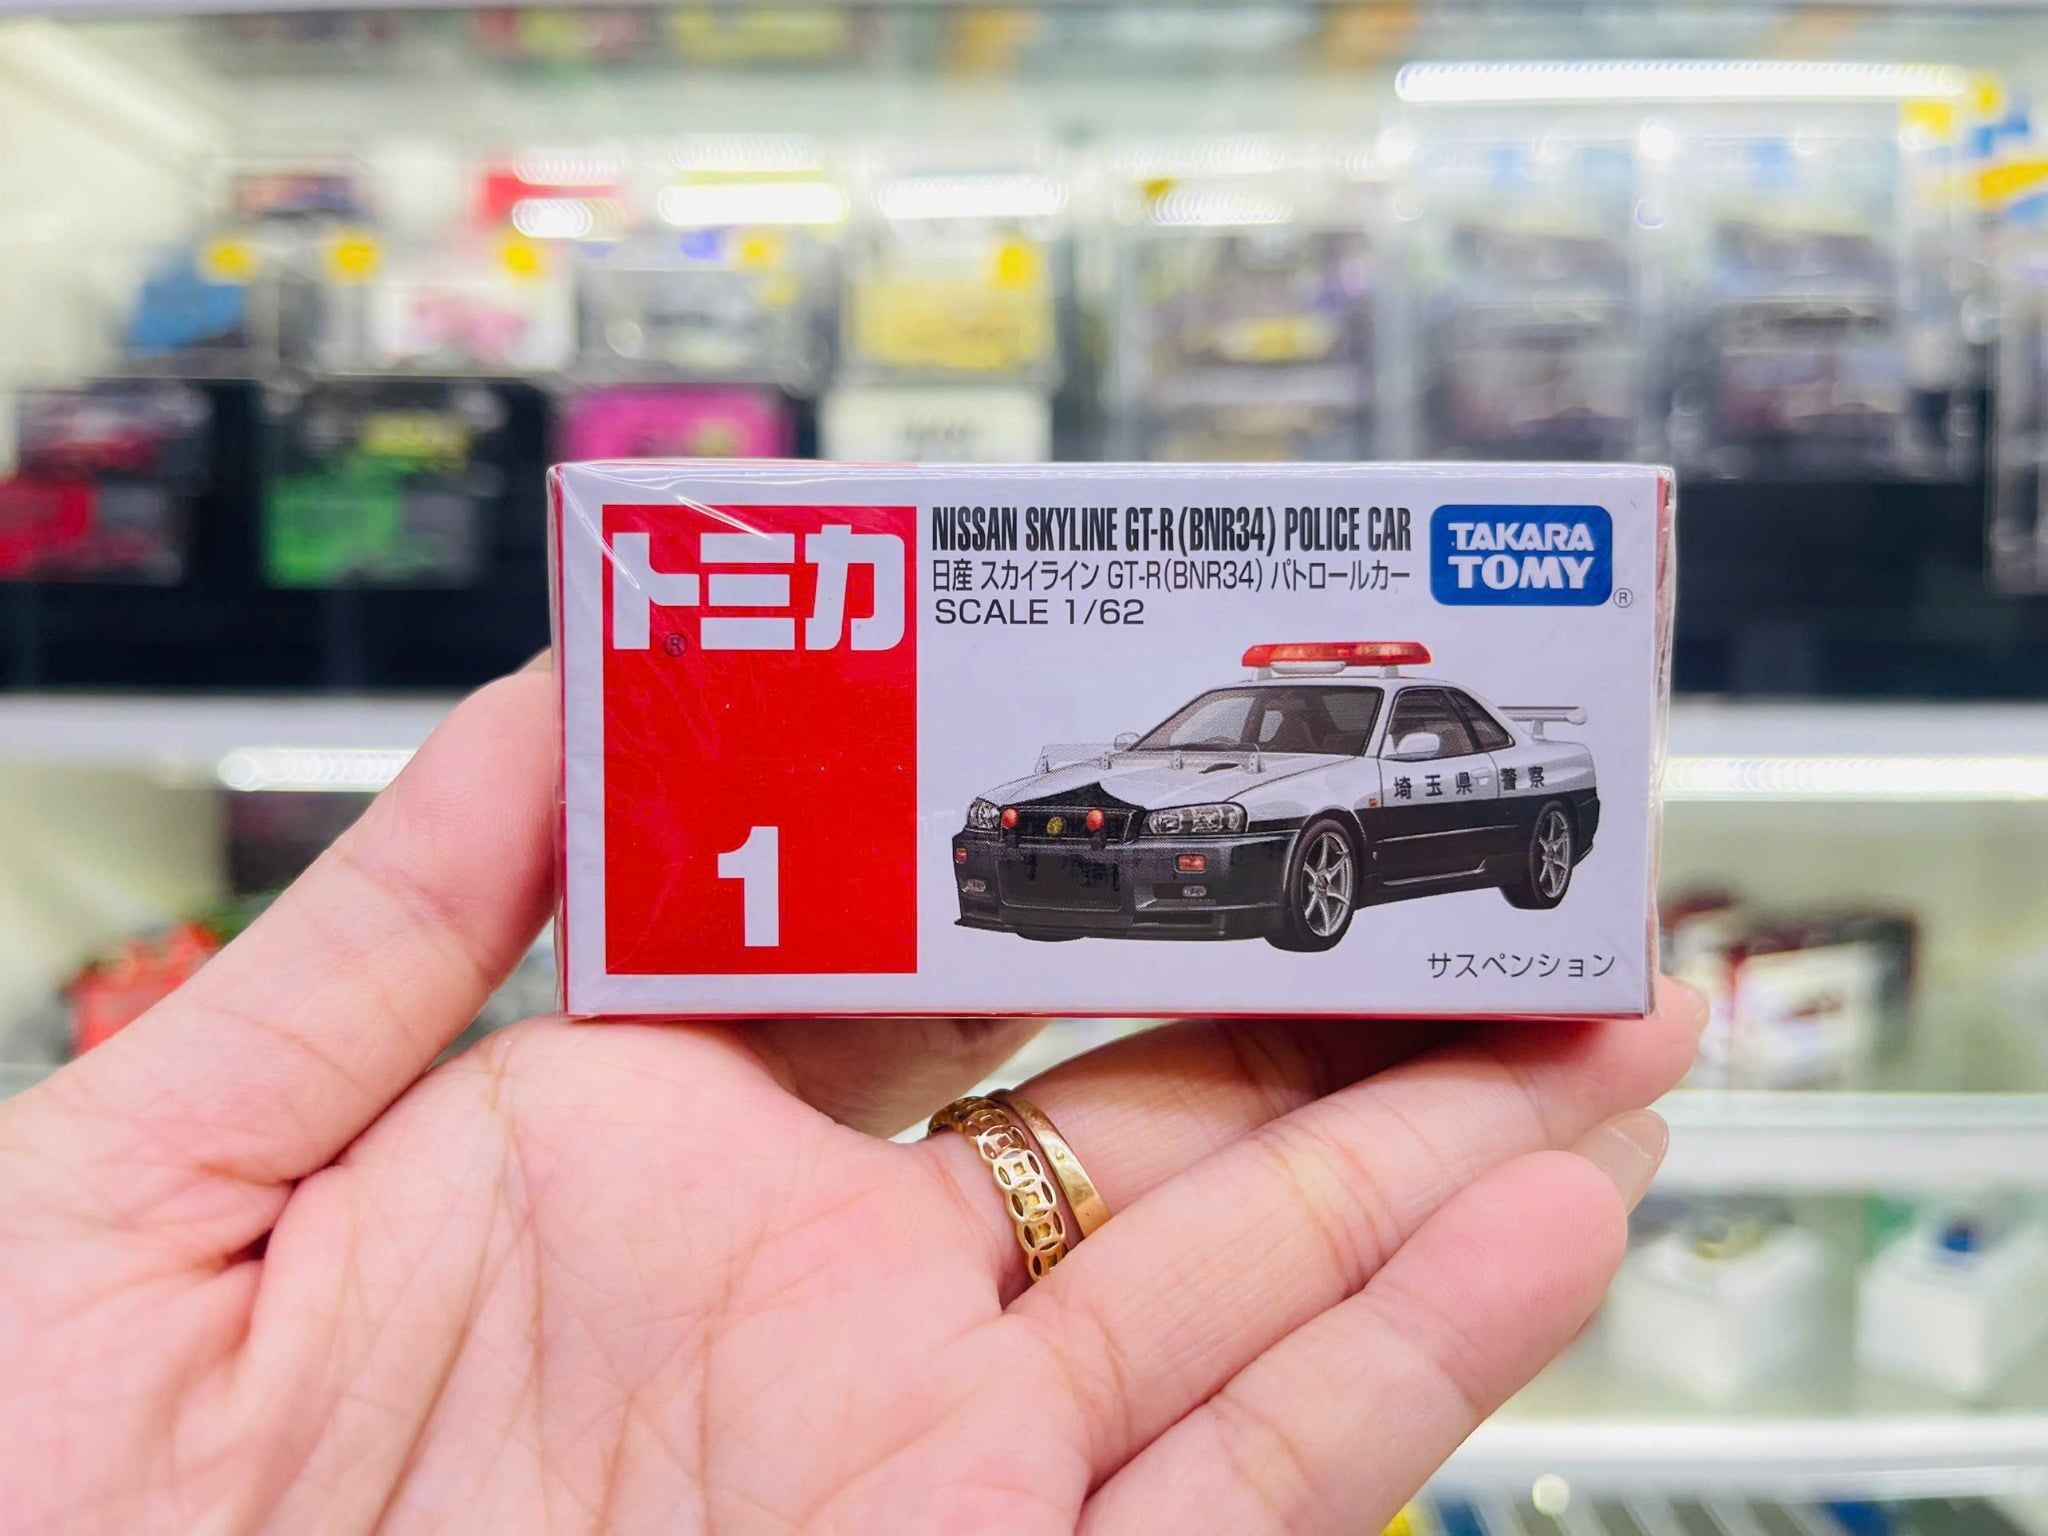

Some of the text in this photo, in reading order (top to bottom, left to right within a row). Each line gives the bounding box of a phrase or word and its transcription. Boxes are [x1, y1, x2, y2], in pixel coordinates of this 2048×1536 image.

[932, 506, 1018, 551] NISSAN
[1025, 506, 1118, 551] SKYLINE
[1284, 506, 1360, 551] POLICE
[1367, 506, 1412, 551] CAR
[1448, 522, 1595, 551] TAKARA
[612, 523, 906, 651] トミカ
[933, 558, 1411, 593] 日産 スカイライン GT-R(BNR34) パトロールカー
[1448, 554, 1595, 590] TOMY
[935, 598, 1145, 625] SCALE 1/62
[717, 825, 780, 948] 1
[1427, 952, 1615, 979] サスペンション
